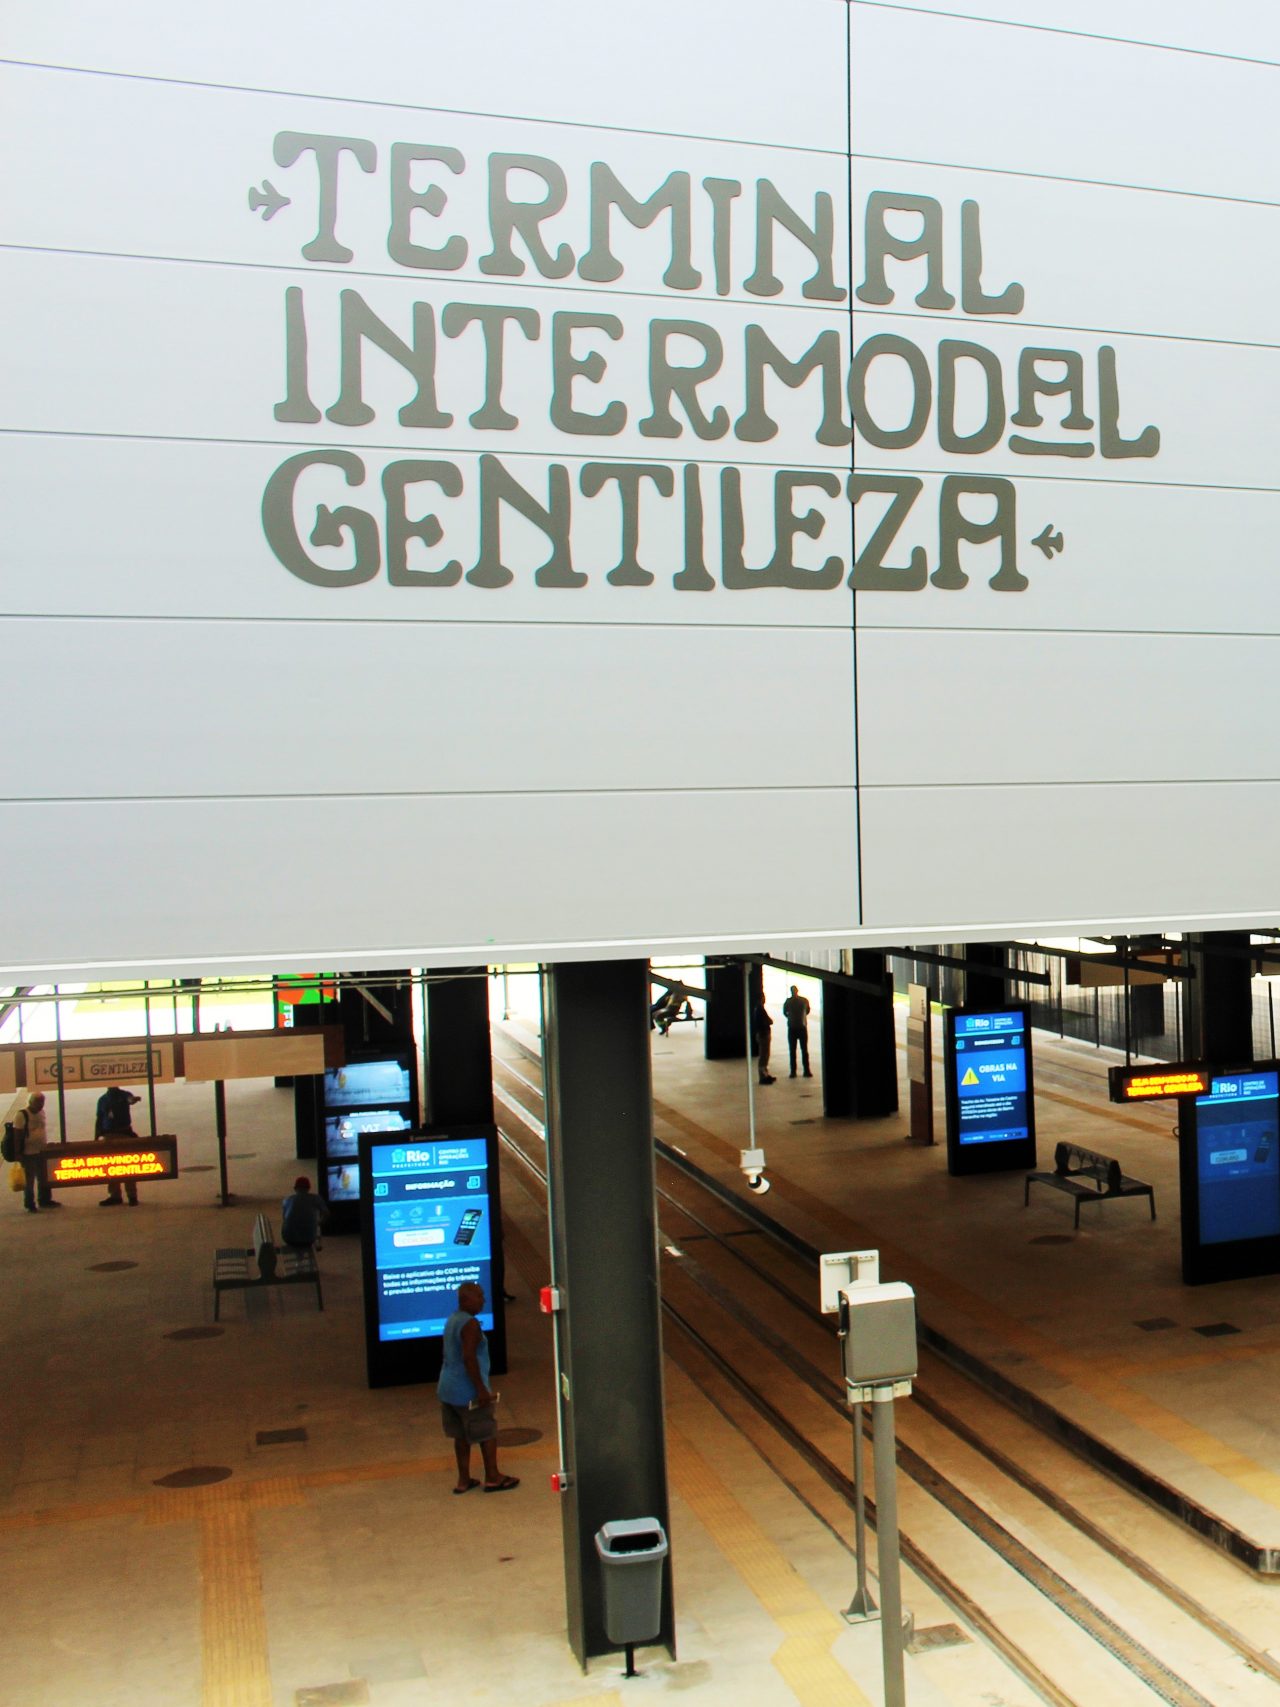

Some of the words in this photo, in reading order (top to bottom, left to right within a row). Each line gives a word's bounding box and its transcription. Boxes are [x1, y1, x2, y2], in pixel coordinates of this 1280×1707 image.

[273, 131, 1026, 317] TERMINAL
[274, 286, 1162, 461] INTERMODAL
[261, 449, 1031, 593] GENTILEZA
[974, 1019, 990, 1028] Rio
[979, 1063, 1005, 1073] OBRAS
[1006, 1063, 1018, 1071] NA
[992, 1074, 1006, 1082] VIA
[1220, 1082, 1238, 1093] Rio
[61, 1158, 85, 1168] SEJA
[86, 1154, 139, 1167] BEM-VINDO
[140, 1153, 155, 1162] AO
[406, 1150, 430, 1163] Rio
[54, 1167, 106, 1180] TERMINAL
[108, 1163, 163, 1176] GENTILEZA
[405, 1180, 455, 1191] INFORMAÇÃO
